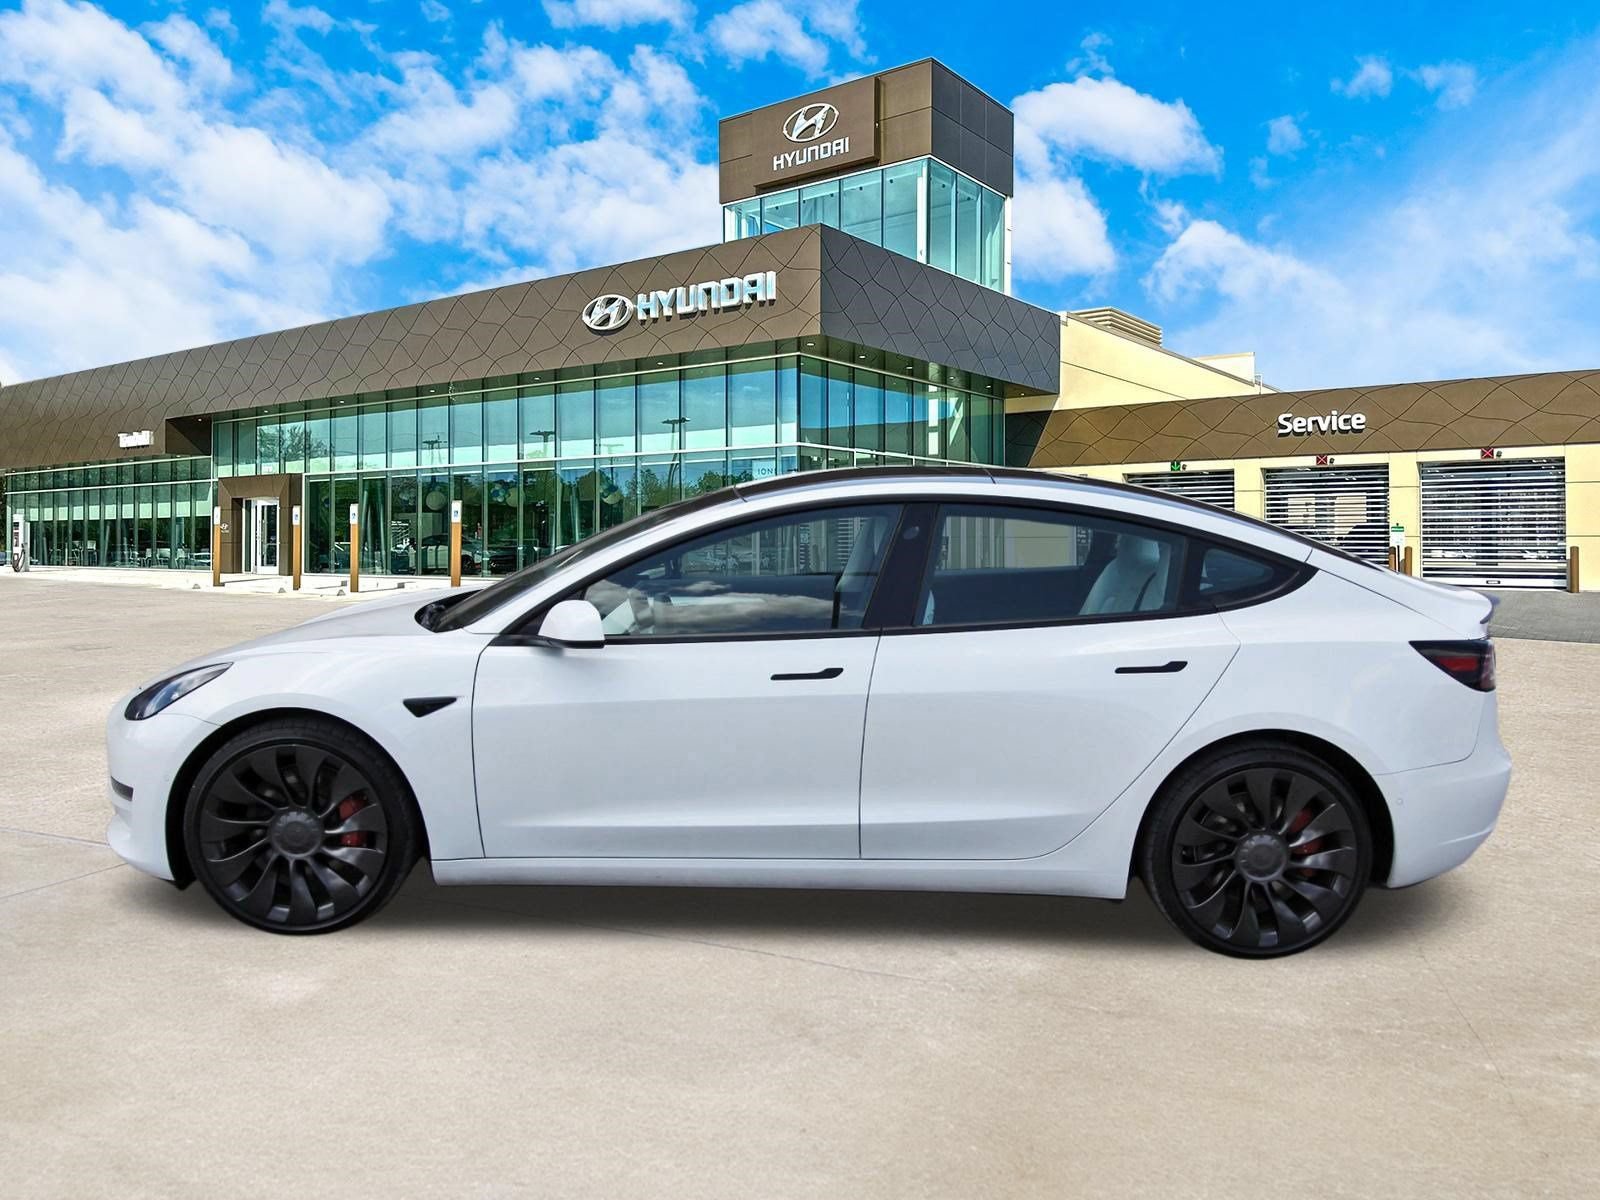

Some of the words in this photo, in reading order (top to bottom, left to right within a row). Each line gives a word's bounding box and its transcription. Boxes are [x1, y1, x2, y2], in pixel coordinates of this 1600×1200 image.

[773, 136, 850, 171] HYUNDAI
[637, 270, 777, 321] HYUNDAI
[1277, 410, 1366, 434] Service
